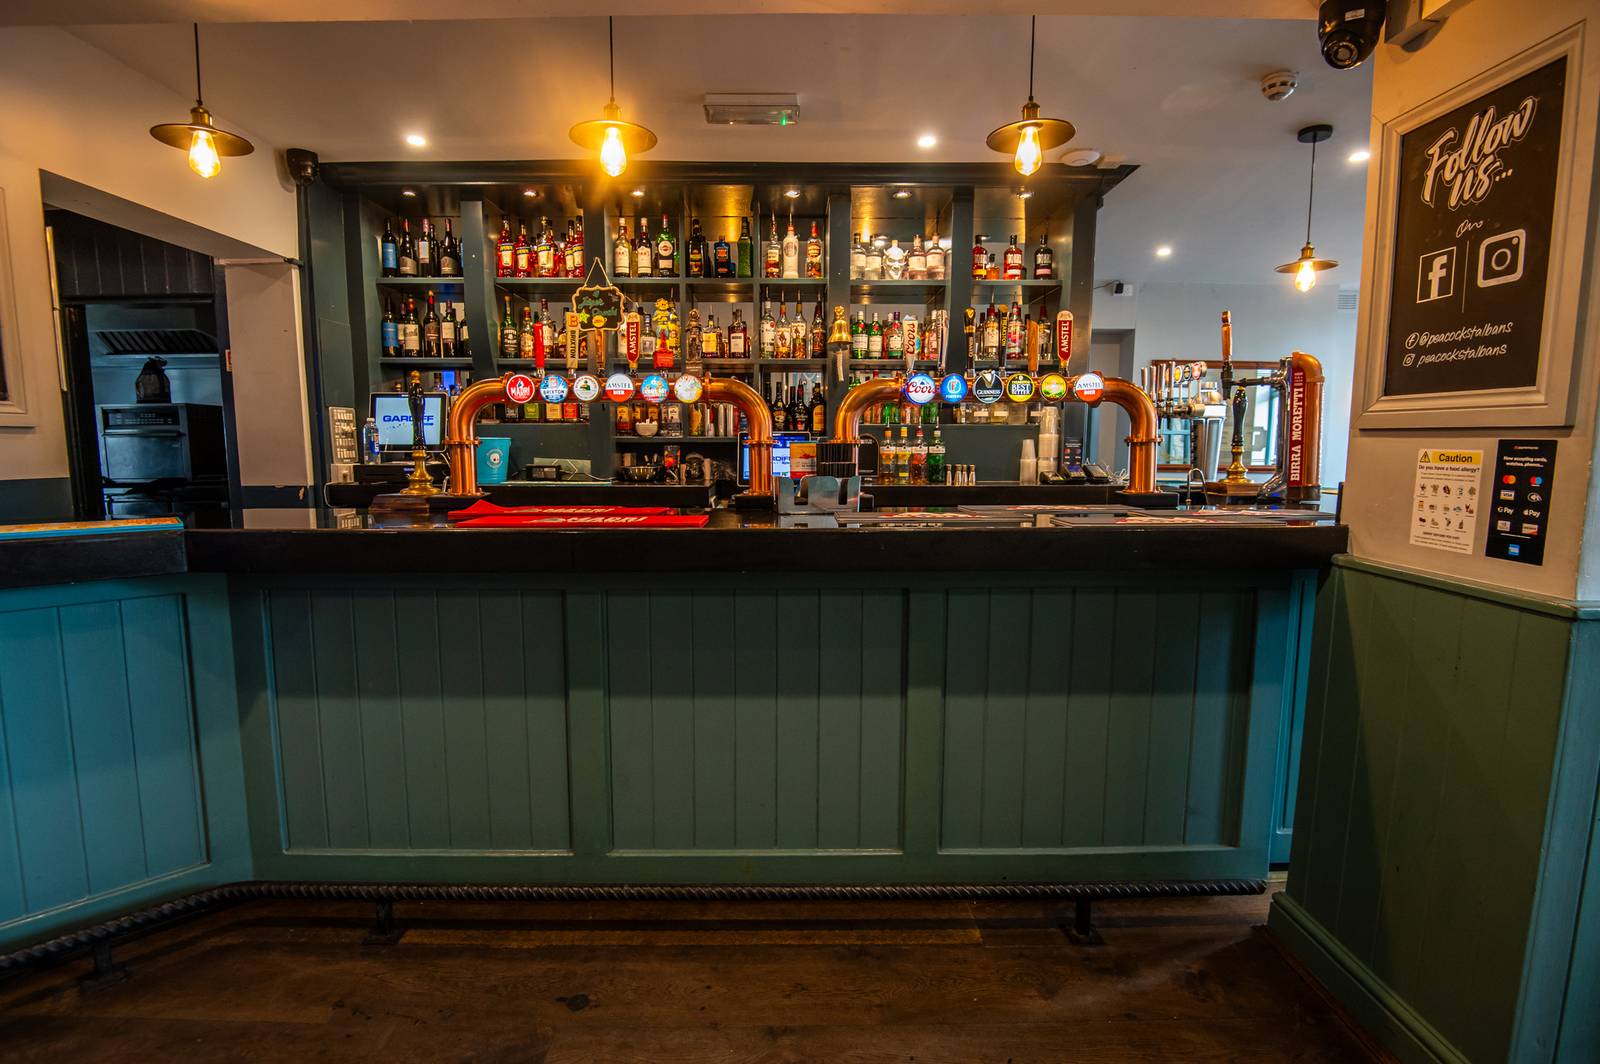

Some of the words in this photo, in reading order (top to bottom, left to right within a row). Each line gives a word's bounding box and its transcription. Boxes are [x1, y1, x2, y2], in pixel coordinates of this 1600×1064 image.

[1422, 97, 1537, 206] Follow
[629, 323, 637, 354] AMSTEL
[906, 322, 916, 354] Coors
[1060, 321, 1070, 353] AMSTEL
[1419, 321, 1514, 348] @peacockstalbans
[1416, 344, 1508, 368] peacockstalbans
[907, 381, 937, 394] Coors
[1292, 388, 1303, 441] MORETTI
[1290, 444, 1302, 481] BIRRA
[1438, 453, 1473, 463] Caution
